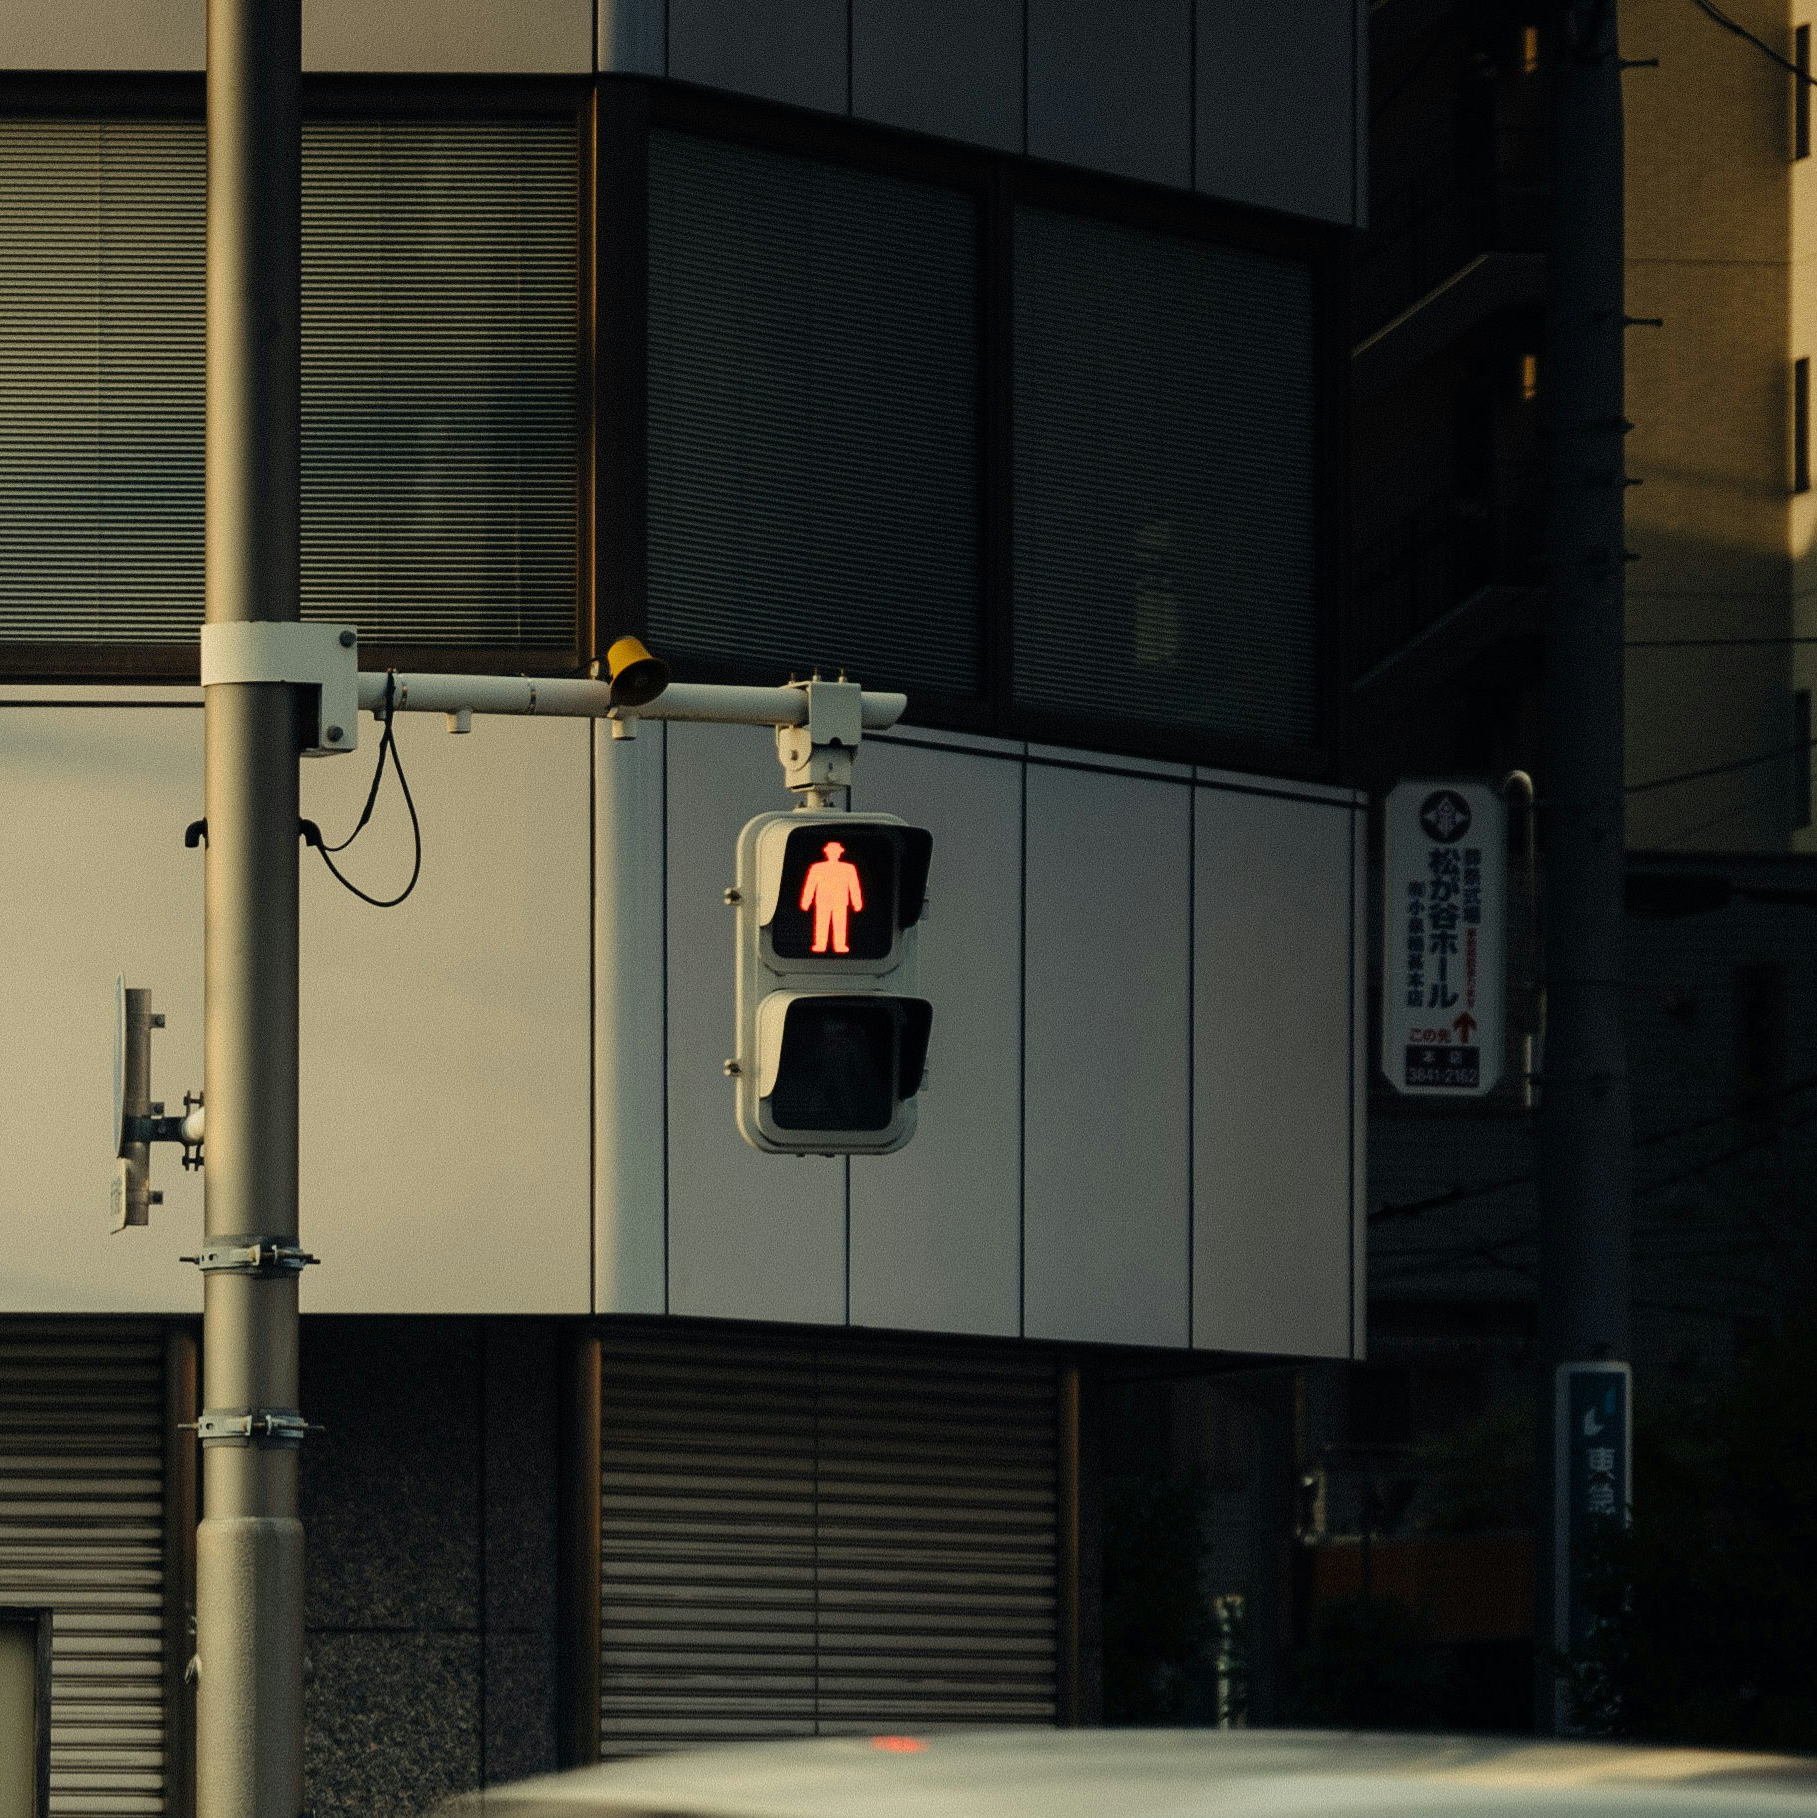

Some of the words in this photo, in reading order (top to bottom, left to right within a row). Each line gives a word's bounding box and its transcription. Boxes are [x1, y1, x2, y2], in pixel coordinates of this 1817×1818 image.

[1428, 849, 1460, 1009] 松が谷ホール
[1409, 1027, 1452, 1044] この先
